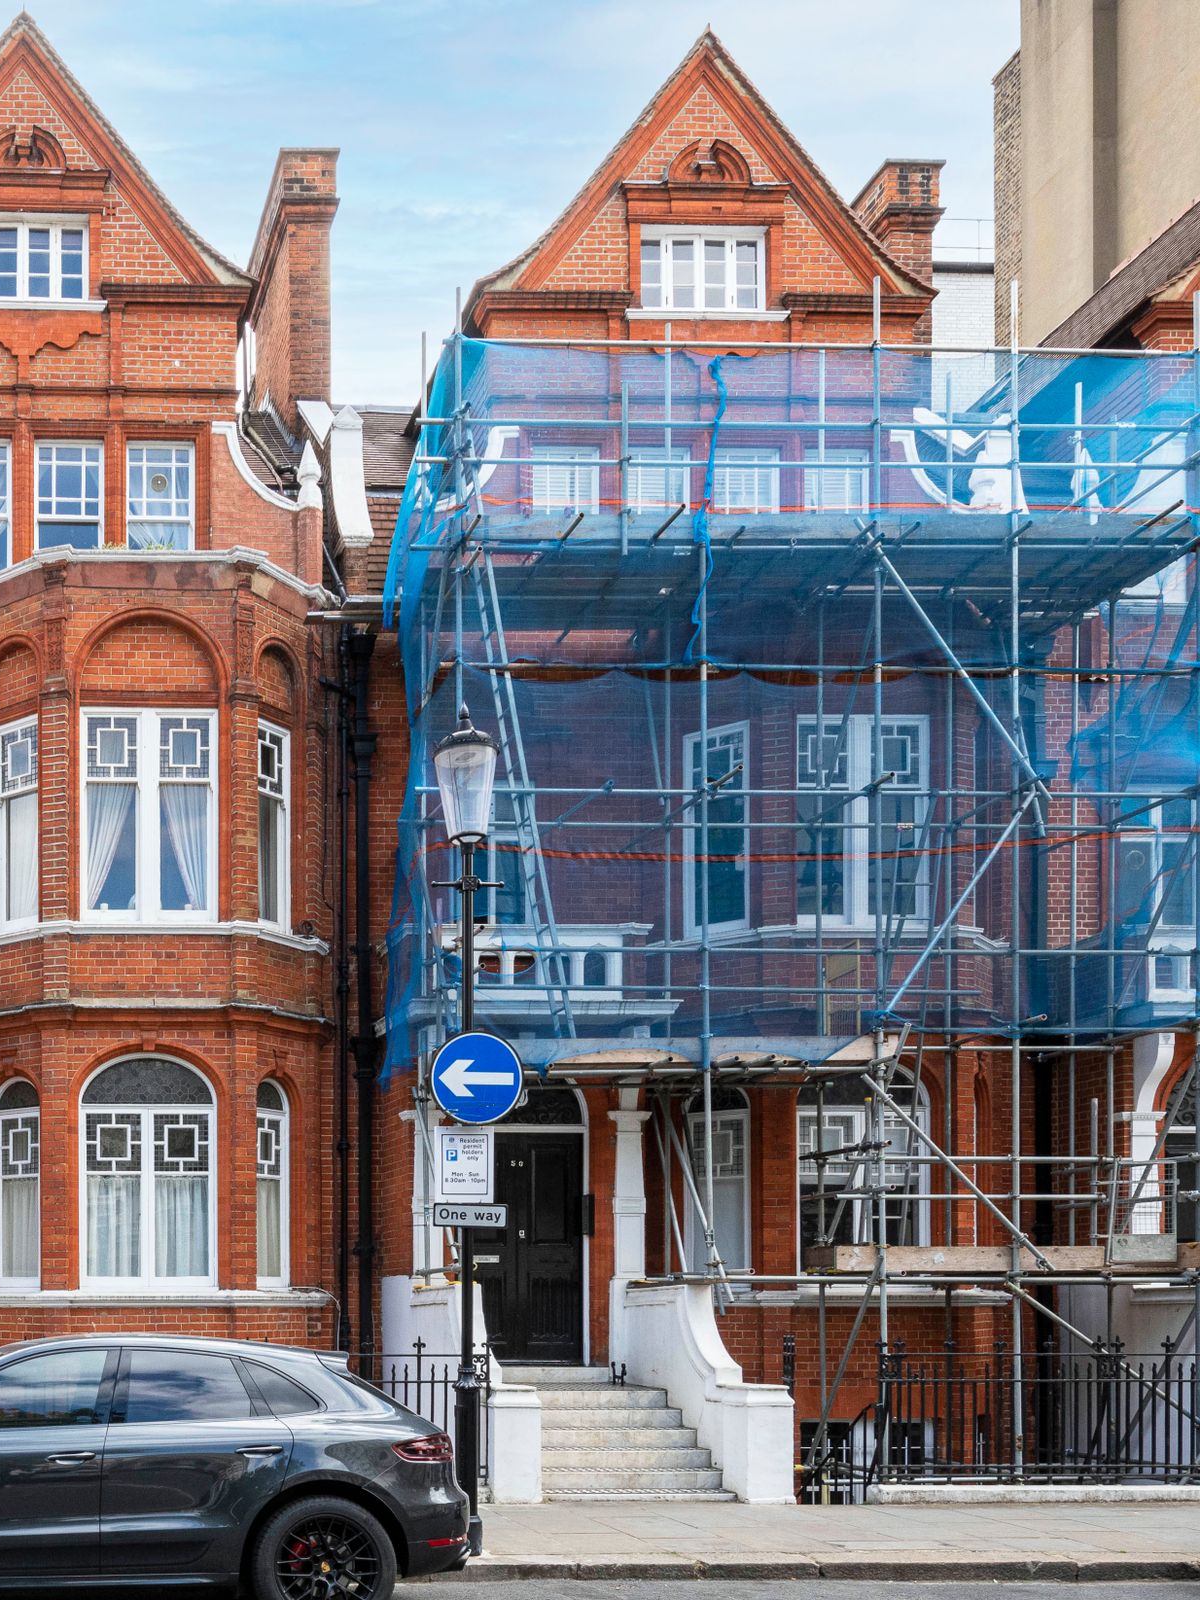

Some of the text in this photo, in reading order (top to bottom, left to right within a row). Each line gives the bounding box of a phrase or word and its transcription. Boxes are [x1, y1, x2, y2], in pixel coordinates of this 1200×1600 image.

[447, 1150, 456, 1160] P
[439, 1208, 502, 1223] One way
